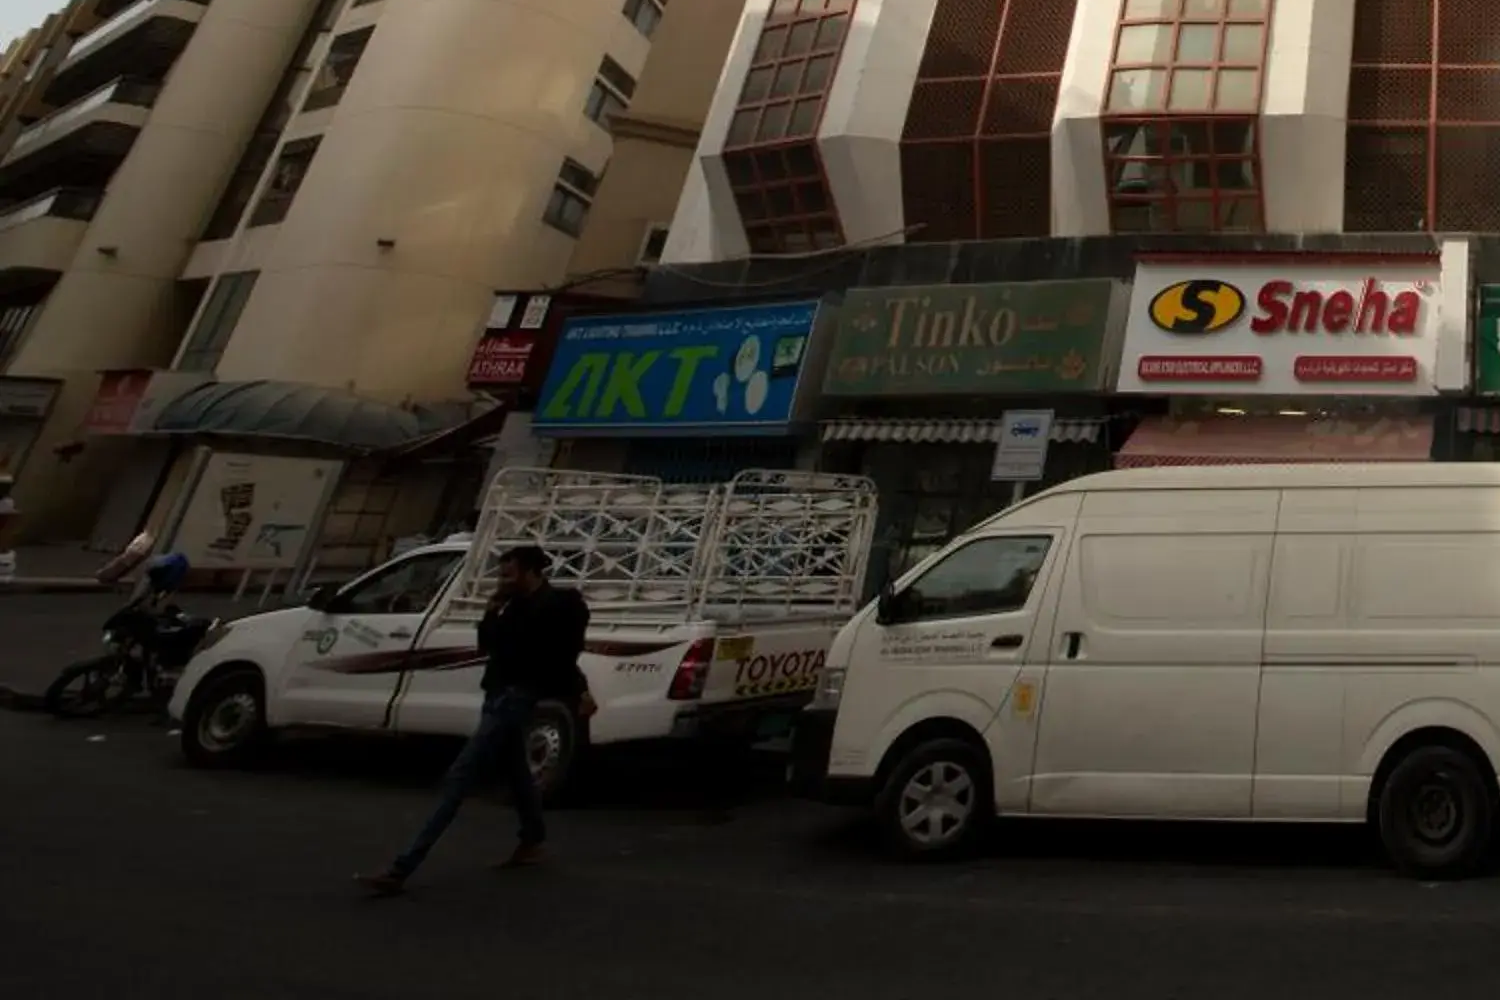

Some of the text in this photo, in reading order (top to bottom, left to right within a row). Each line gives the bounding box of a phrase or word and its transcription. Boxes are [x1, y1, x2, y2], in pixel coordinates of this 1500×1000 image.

[884, 295, 1019, 350] Tinko
[1249, 276, 1422, 334] Sneha
[541, 345, 719, 419] AKT
[736, 649, 826, 682] TOYOTA
